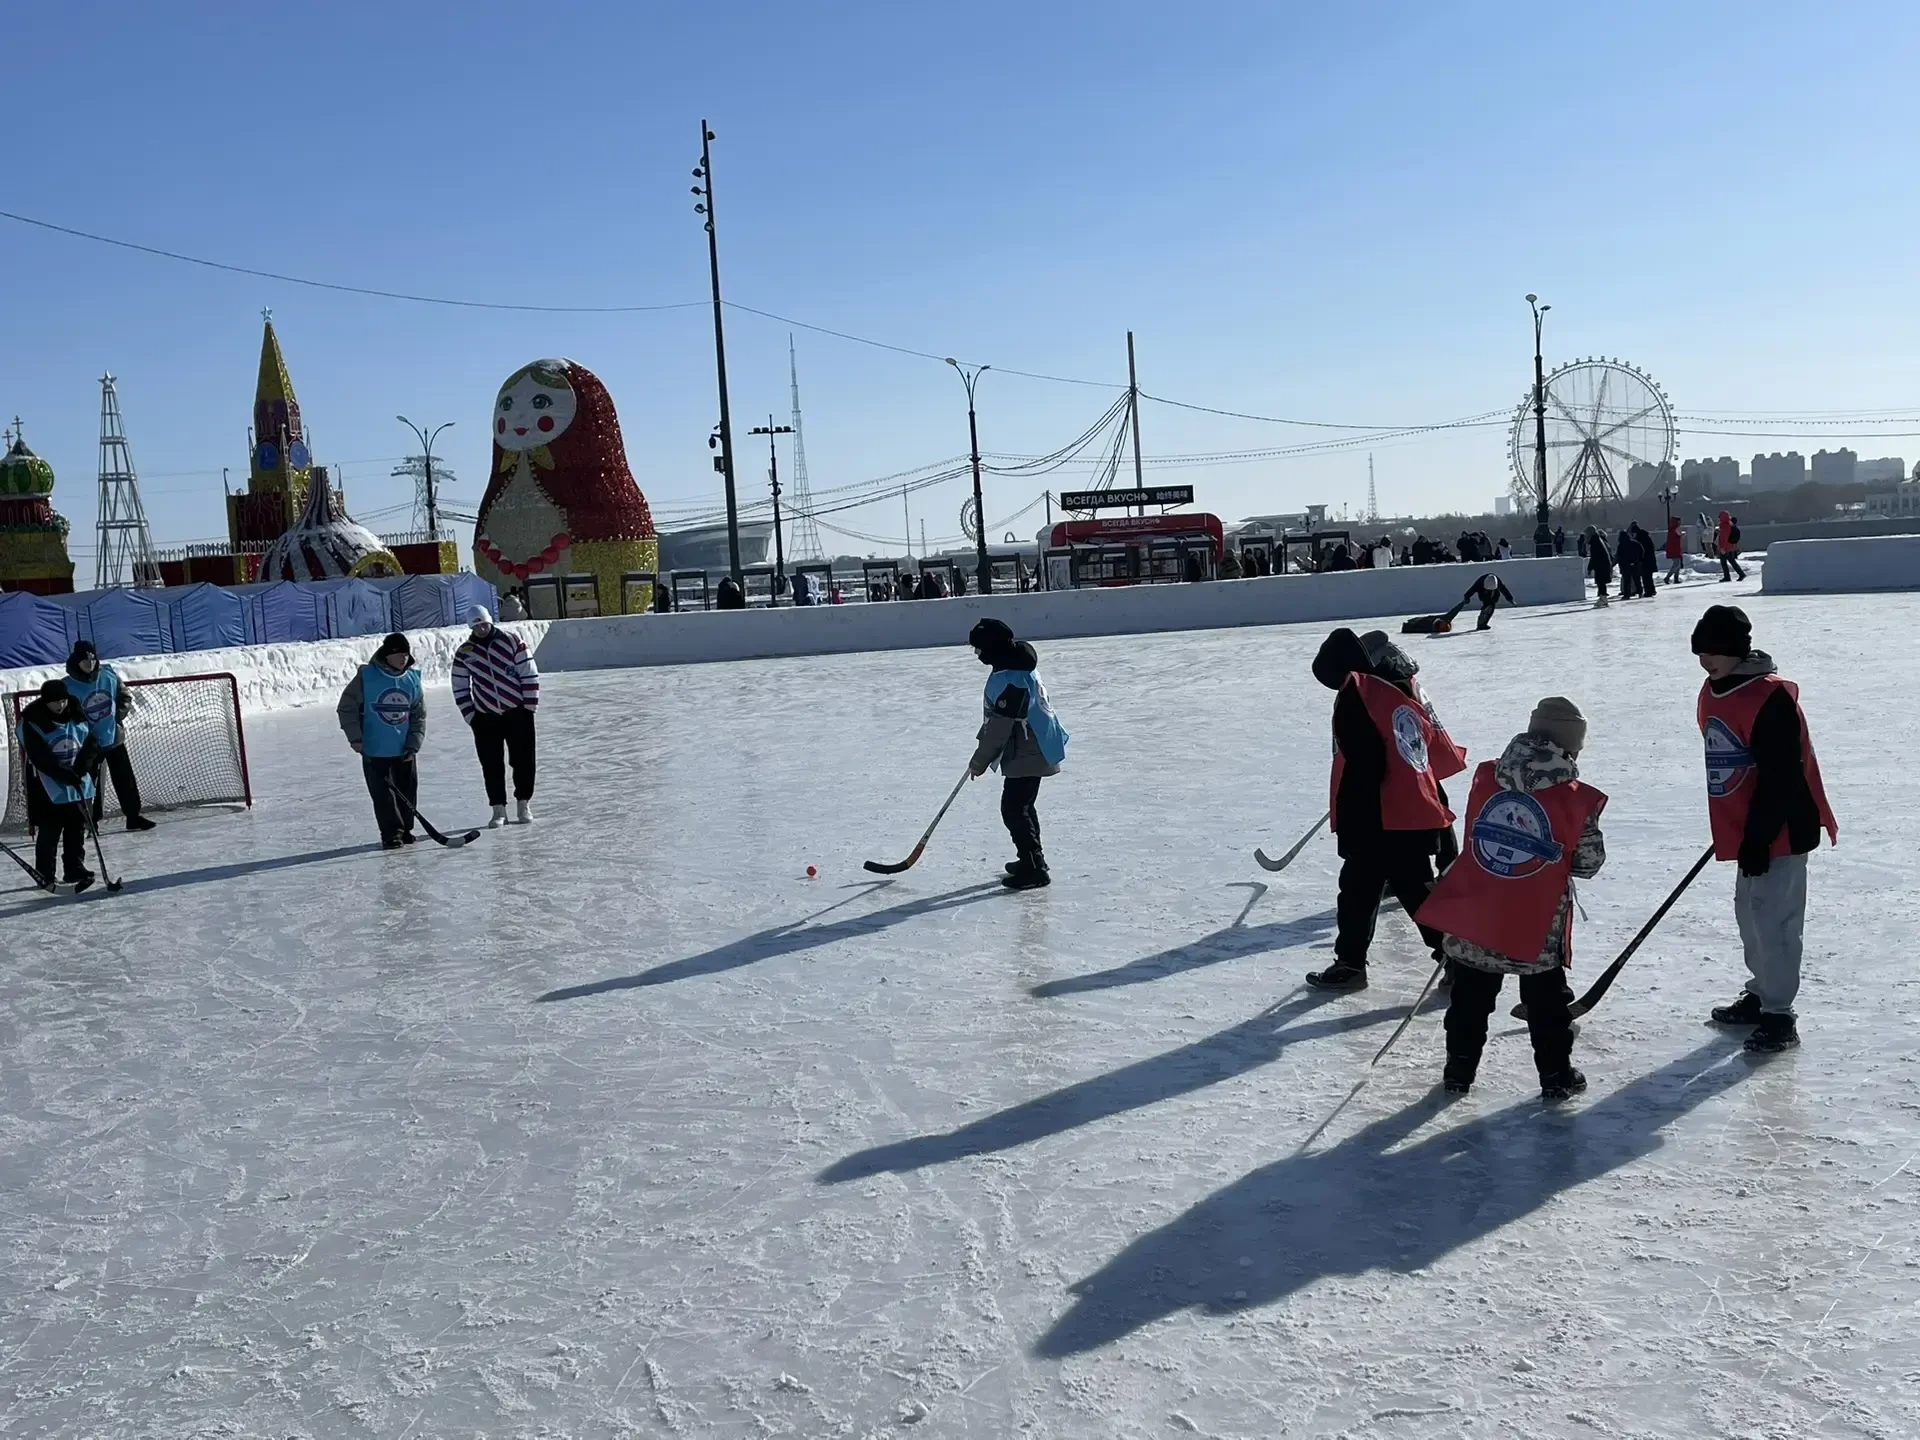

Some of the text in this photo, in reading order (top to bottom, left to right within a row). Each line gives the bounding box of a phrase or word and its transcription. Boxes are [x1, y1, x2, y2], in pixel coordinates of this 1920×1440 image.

[1066, 492, 1148, 506] ВСЕГДА ВКУСНО
[1102, 519, 1130, 527] ВСЕГДА
[1491, 861, 1509, 873] 2023
